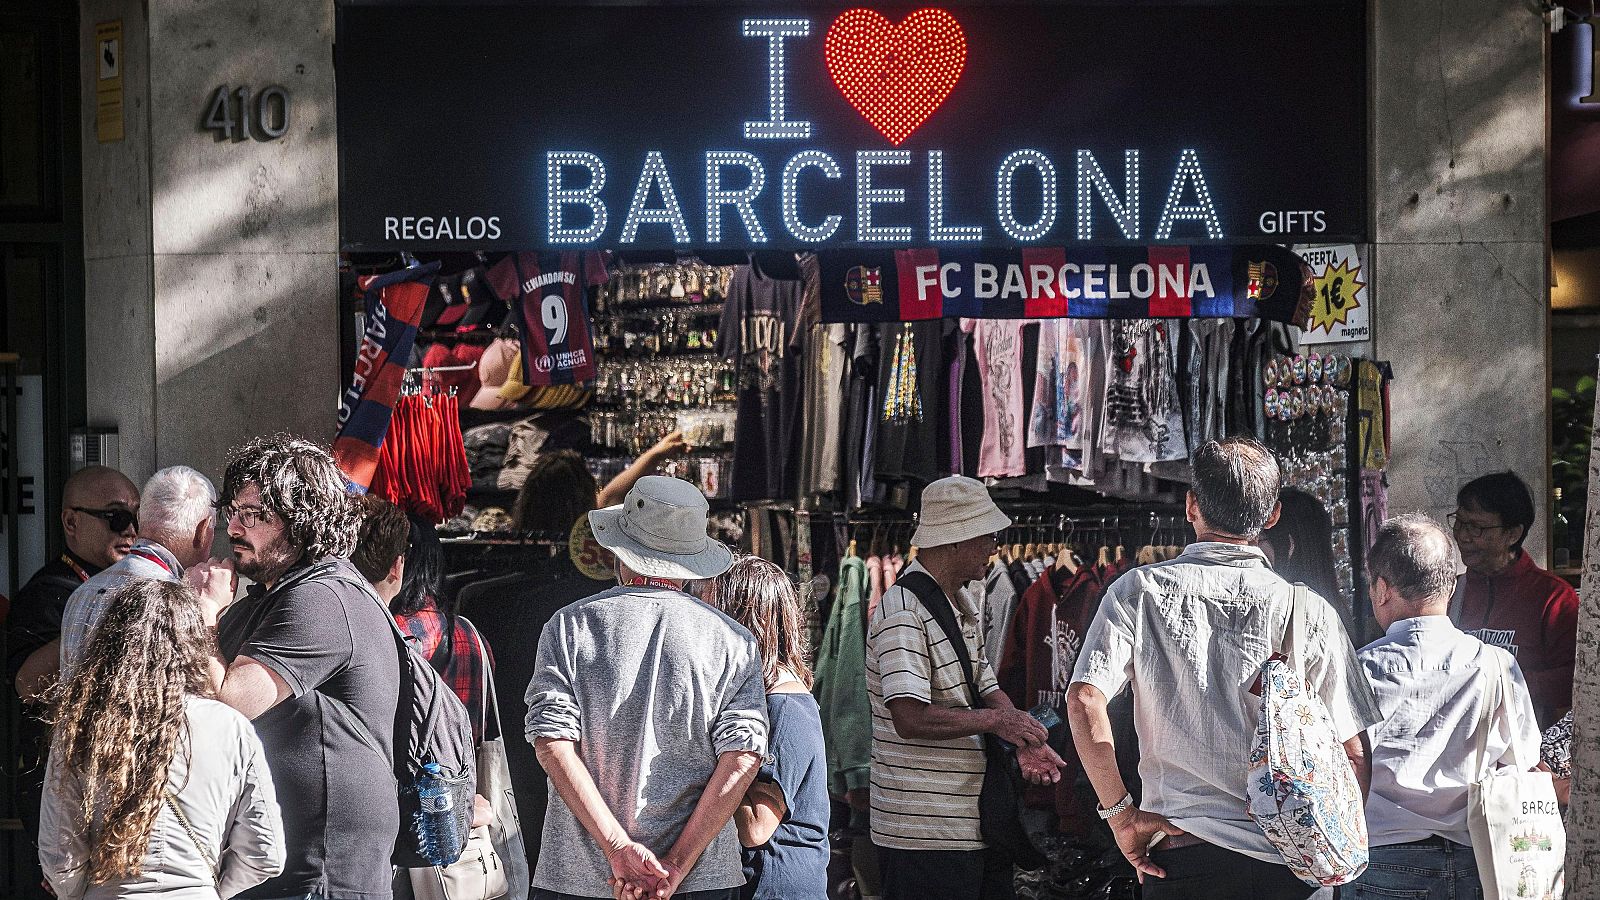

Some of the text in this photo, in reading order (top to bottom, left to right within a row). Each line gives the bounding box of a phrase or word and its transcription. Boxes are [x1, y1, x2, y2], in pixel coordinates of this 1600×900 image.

[742, 18, 811, 139] I
[206, 85, 291, 138] 410
[546, 148, 1224, 244] BARCELONA
[385, 216, 501, 240] REGALOS
[1259, 210, 1327, 233] GIFTS
[1302, 249, 1338, 266] OFERTA
[522, 271, 577, 294] LEWANDOWSKI
[916, 262, 1215, 301] FC BARCELONA
[1321, 277, 1346, 315] 1€
[541, 294, 568, 346] 9
[1341, 326, 1368, 338] magnets
[556, 349, 585, 361] UNHCR
[557, 356, 587, 368] ACNUR
[1522, 800, 1558, 815] BARCE
